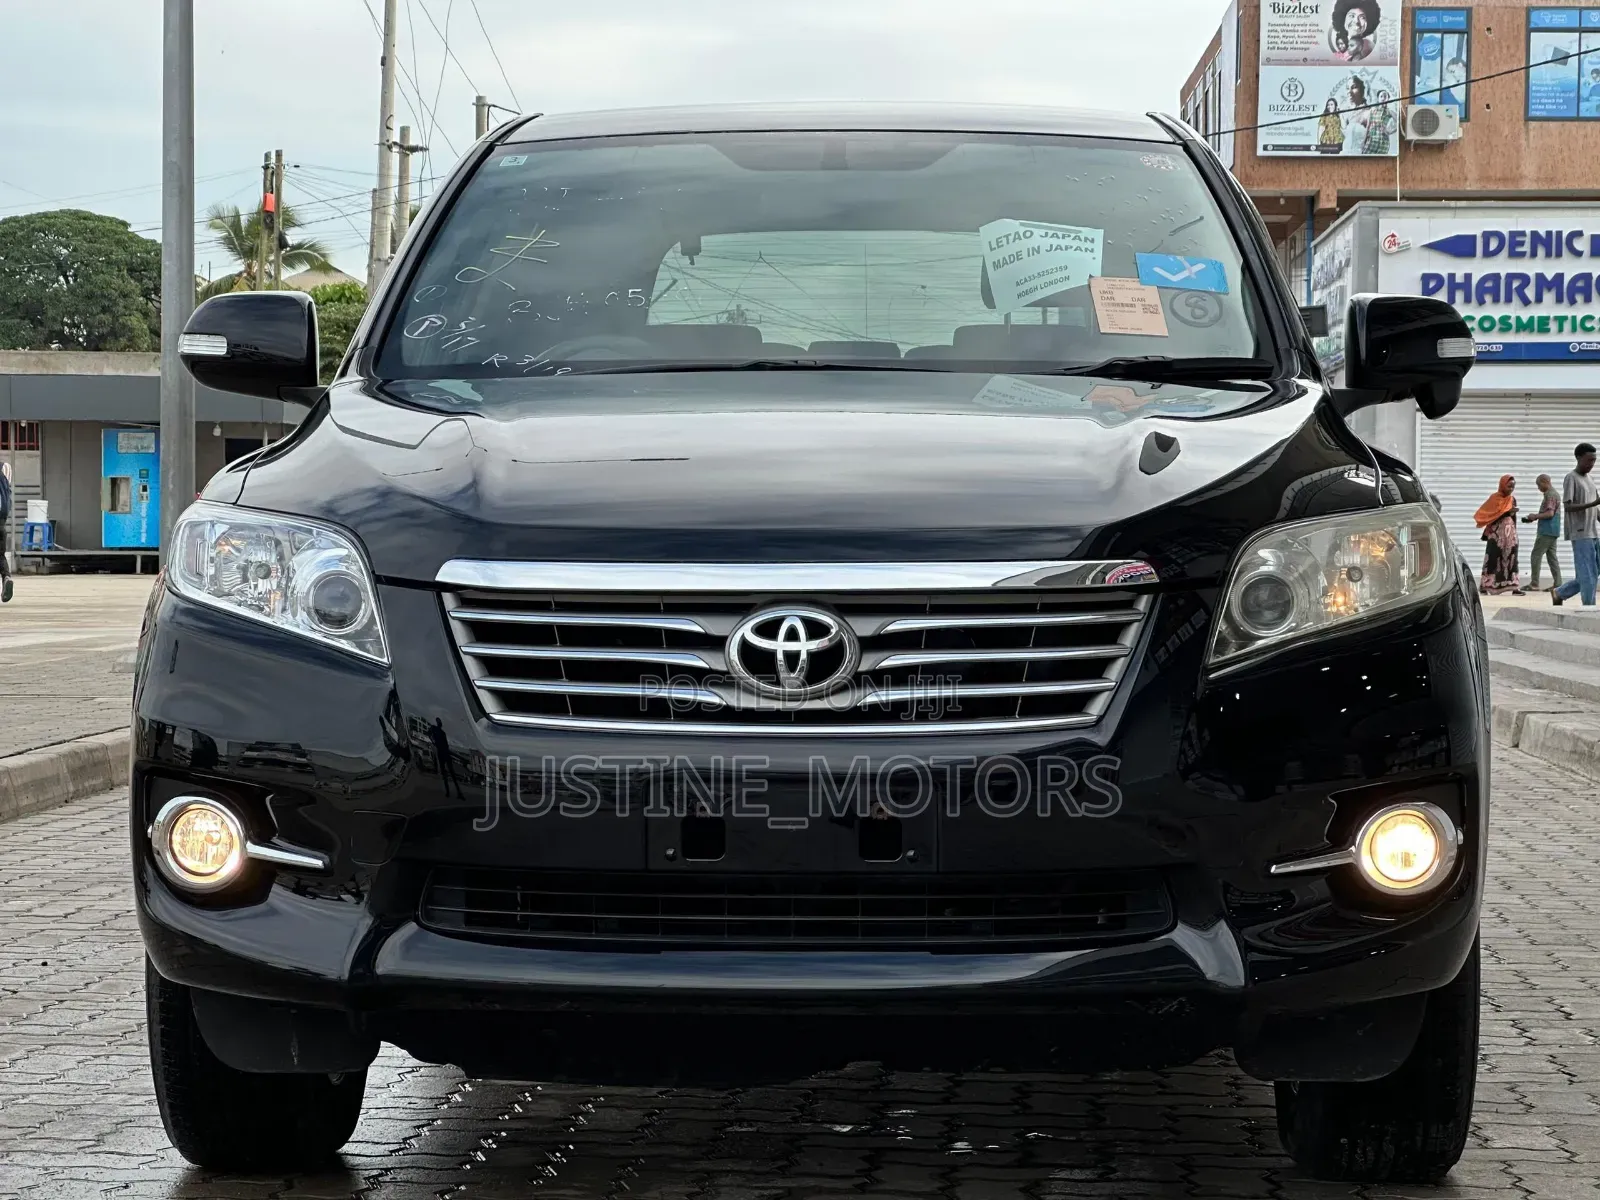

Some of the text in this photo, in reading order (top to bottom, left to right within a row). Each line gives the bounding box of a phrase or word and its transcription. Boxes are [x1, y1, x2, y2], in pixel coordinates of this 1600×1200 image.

[1269, 2, 1320, 14] Bizzlest
[1268, 104, 1318, 112] BIZZLEST
[988, 229, 1095, 253] LETAO JAPAN
[1481, 230, 1584, 258] DENIC
[992, 243, 1095, 271] MADE IN JAPAN
[1015, 264, 1068, 287] ACA33-5252359
[1016, 275, 1070, 300] HOEGH LONDON
[1420, 272, 1600, 307] PHARMA
[1463, 315, 1600, 333] COSMETIC
